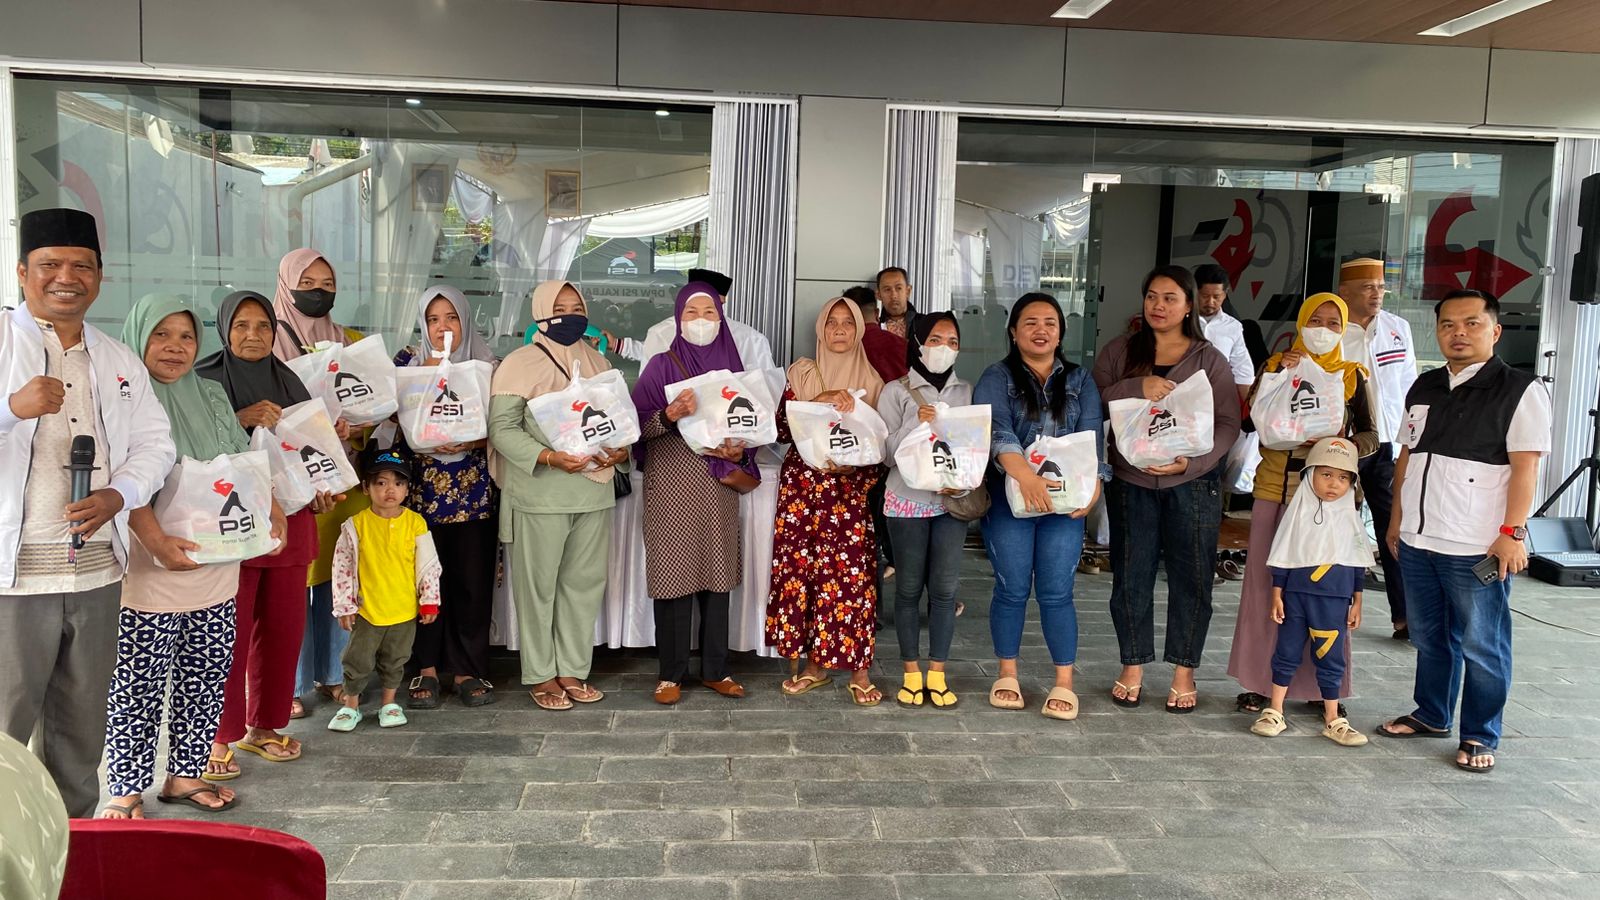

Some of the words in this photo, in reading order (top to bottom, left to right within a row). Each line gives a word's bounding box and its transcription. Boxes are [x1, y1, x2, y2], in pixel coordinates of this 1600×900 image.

[336, 384, 374, 402] PSI
[430, 404, 464, 416] PSI
[582, 419, 616, 442] PSI
[727, 415, 758, 428] PSI
[1148, 418, 1177, 437] PSI
[829, 436, 859, 449] PSI
[305, 457, 338, 478] PSI
[219, 514, 256, 535] PSI
[1308, 626, 1340, 660] 7
